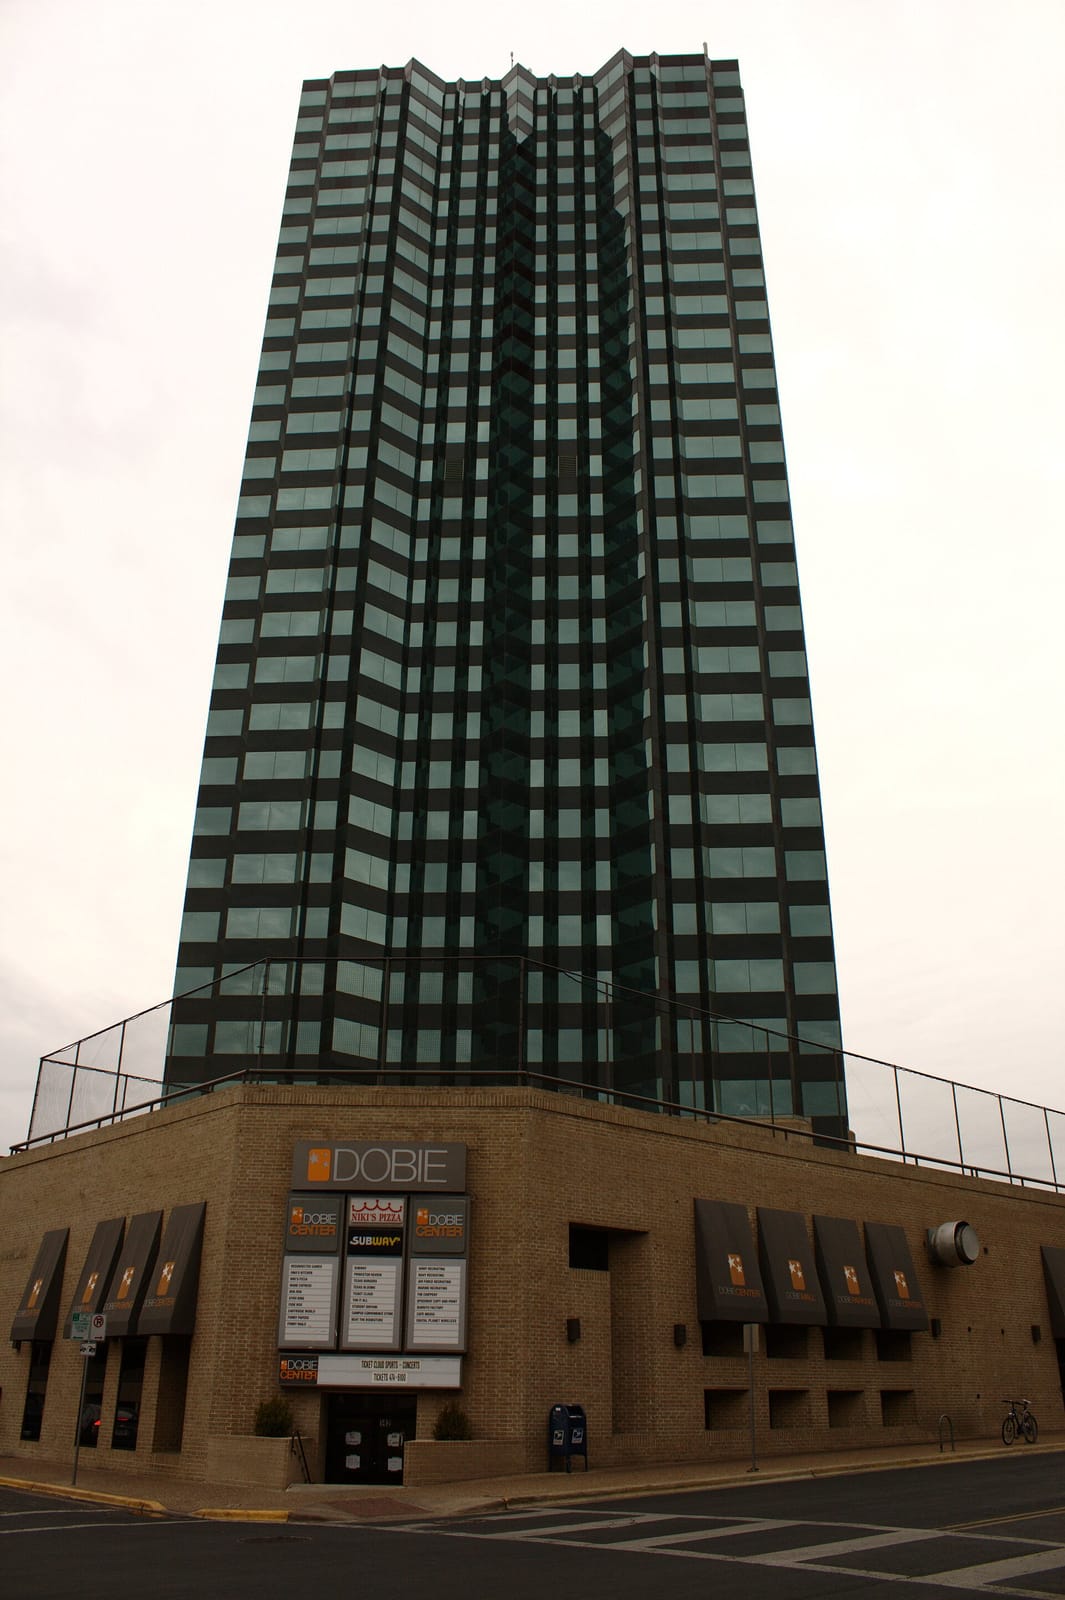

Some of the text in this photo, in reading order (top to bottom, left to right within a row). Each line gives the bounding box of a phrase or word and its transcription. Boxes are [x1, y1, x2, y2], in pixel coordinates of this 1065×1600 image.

[333, 1148, 448, 1183] DOBIE
[303, 1213, 337, 1225] DOBIE
[351, 1213, 402, 1222] NIKI'S PIZZA
[428, 1214, 463, 1226] DOBIE
[289, 1225, 337, 1236] CENTER
[415, 1226, 463, 1237] CENTER
[350, 1236, 401, 1246] SUBWAY
[287, 1359, 318, 1370] DOBIE
[361, 1360, 373, 1369] TICKET
[279, 1370, 318, 1380] CENTER
